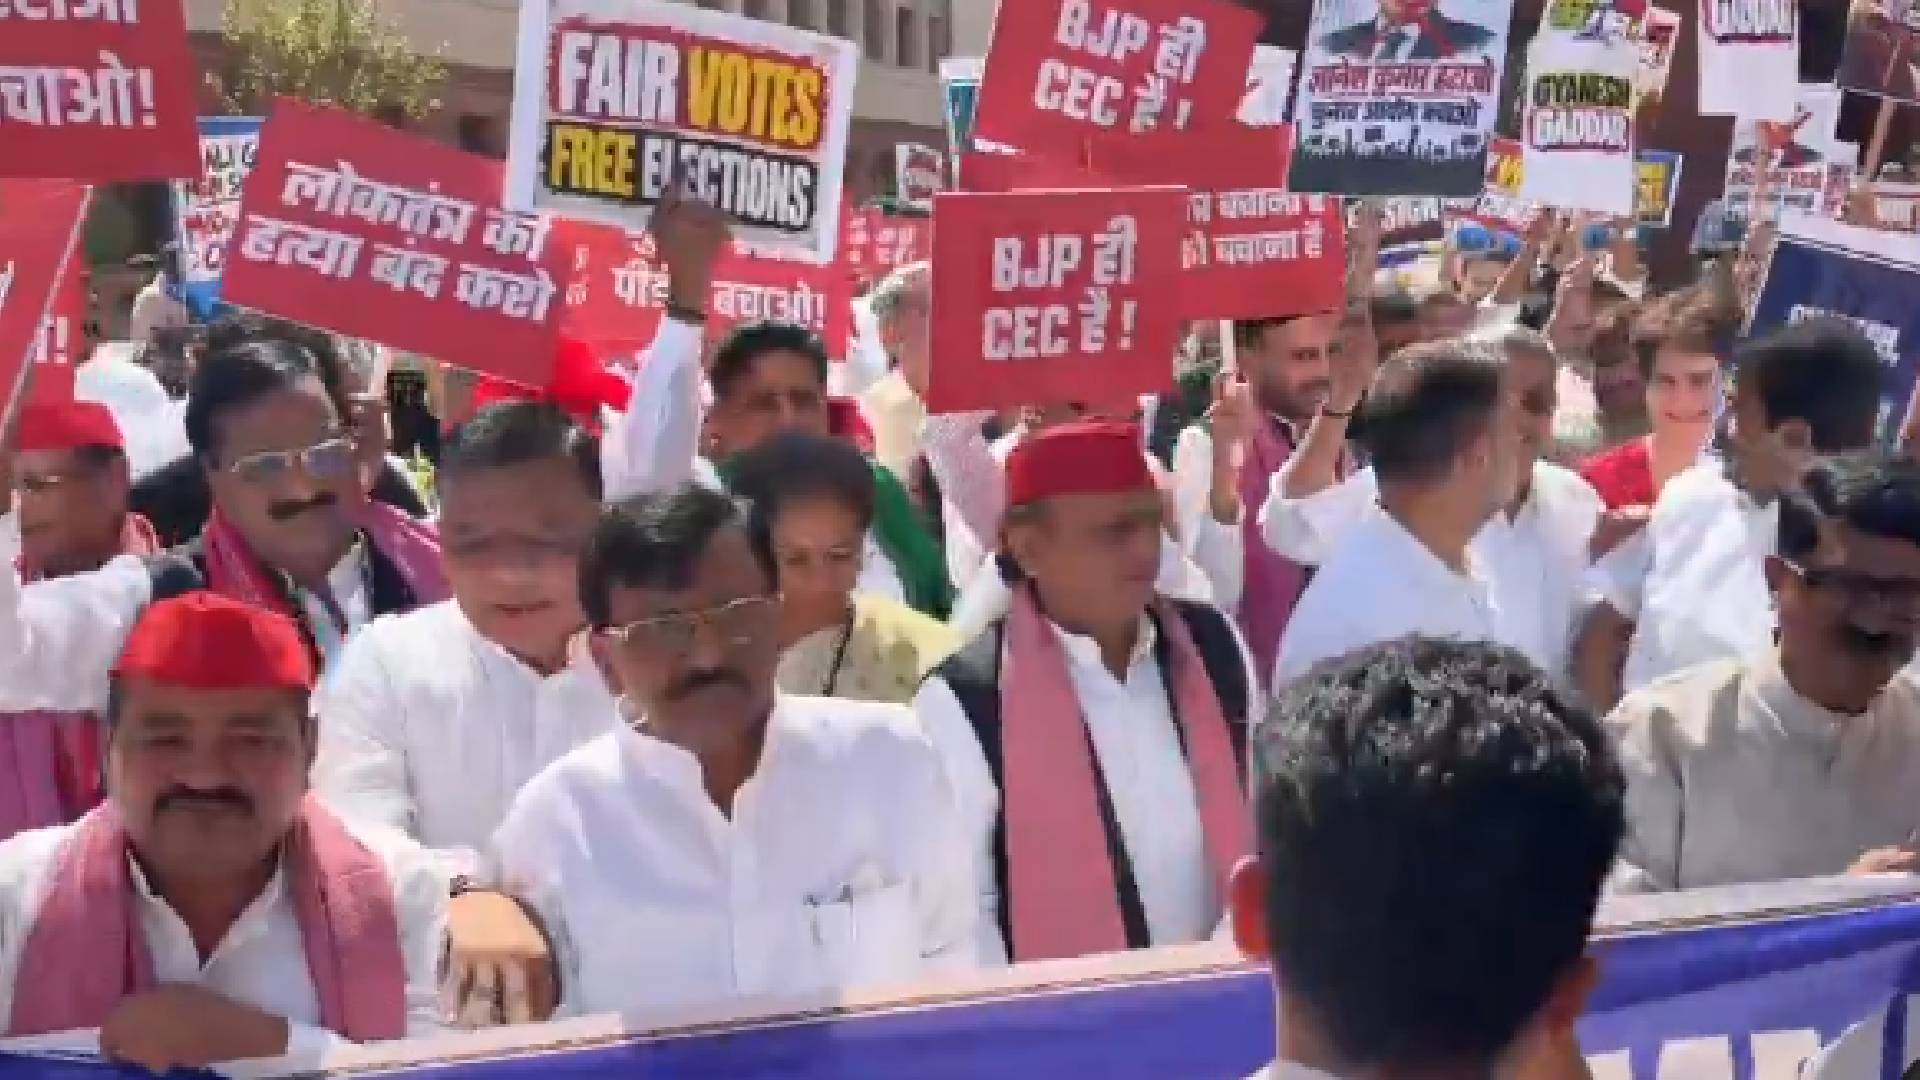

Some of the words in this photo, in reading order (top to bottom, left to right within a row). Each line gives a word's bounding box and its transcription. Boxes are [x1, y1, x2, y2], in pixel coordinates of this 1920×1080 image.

[1057, 0, 1149, 60] BJP
[1154, 17, 1206, 83] ही
[0, 50, 157, 127] चाओ!
[560, 32, 678, 124] FAIR
[687, 46, 822, 146] VOTES
[1034, 59, 1124, 126] CEC
[550, 127, 637, 196] FREE
[283, 160, 475, 246] लोकतंत्र
[242, 214, 364, 279] हत्या
[456, 262, 557, 322] करो
[991, 233, 1083, 292] BJP
[1092, 214, 1138, 285] ही
[981, 305, 1070, 360] CEC
